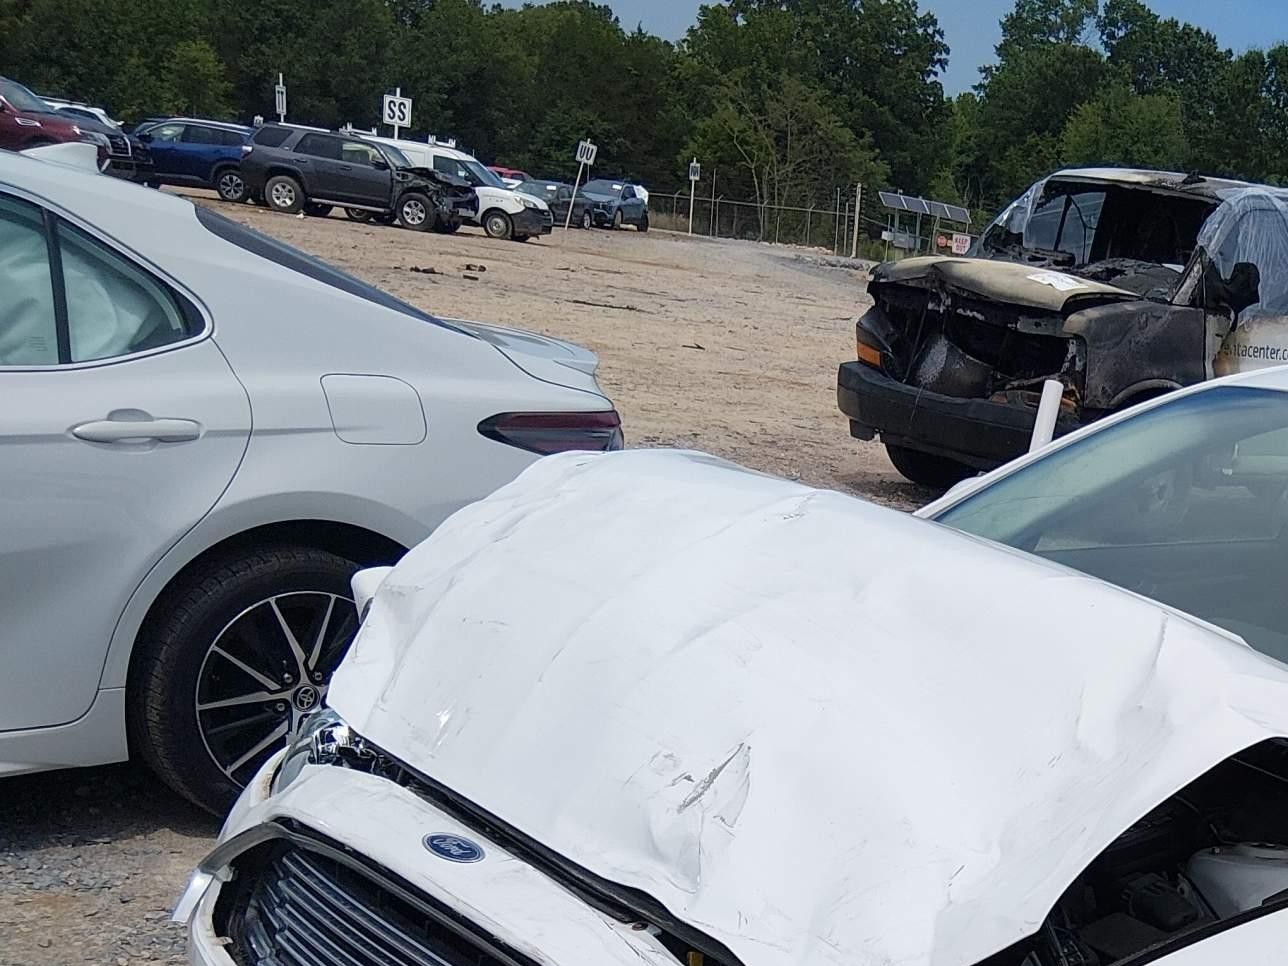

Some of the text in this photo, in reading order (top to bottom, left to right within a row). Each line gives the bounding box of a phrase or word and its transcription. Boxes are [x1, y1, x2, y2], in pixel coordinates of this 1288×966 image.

[387, 100, 407, 122] SS
[579, 144, 594, 161] UU
[432, 837, 472, 856] Ford
